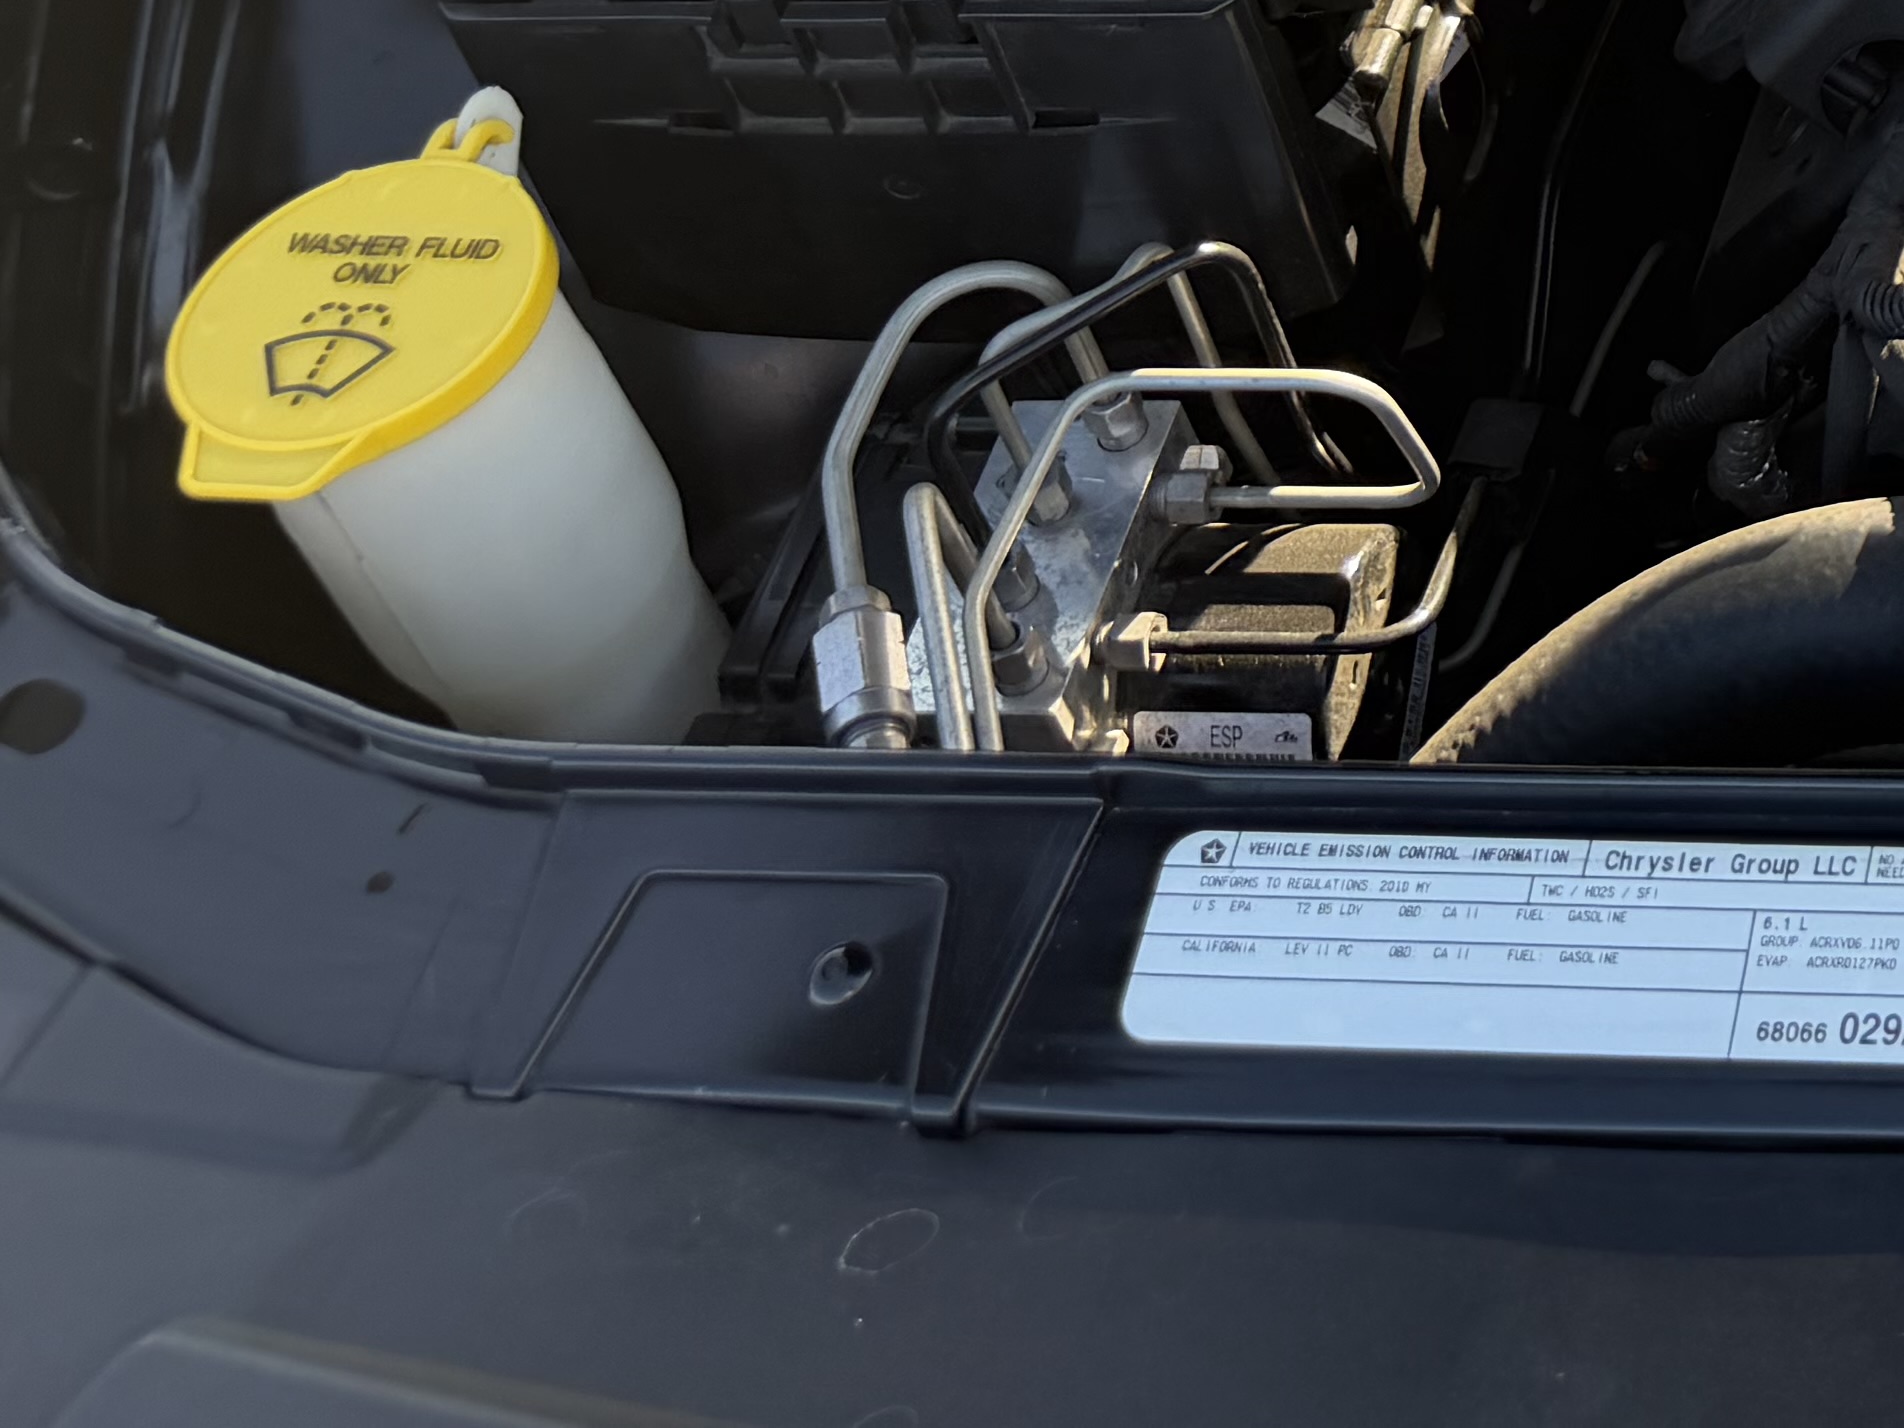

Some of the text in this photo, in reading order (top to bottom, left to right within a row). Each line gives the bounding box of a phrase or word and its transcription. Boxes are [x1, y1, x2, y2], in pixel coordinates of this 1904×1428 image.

[287, 232, 501, 261] WASHER FLUID
[332, 261, 411, 285] ONLY
[1210, 724, 1243, 749] ESP
[1249, 842, 1570, 863] VEHICLE EMISSION CONTROL INFORMATION
[1605, 849, 1858, 882] Chrysler Group LLC
[1200, 875, 1259, 889] CONFORMS
[1266, 876, 1281, 889] TO
[1379, 880, 1409, 893] 2010
[1541, 884, 1565, 896] TWC
[1568, 909, 1628, 923] GASOLINE
[1763, 916, 1809, 931] 6.1 L
[1559, 950, 1619, 964] GASOLINE
[1756, 1020, 1828, 1044] 68066
